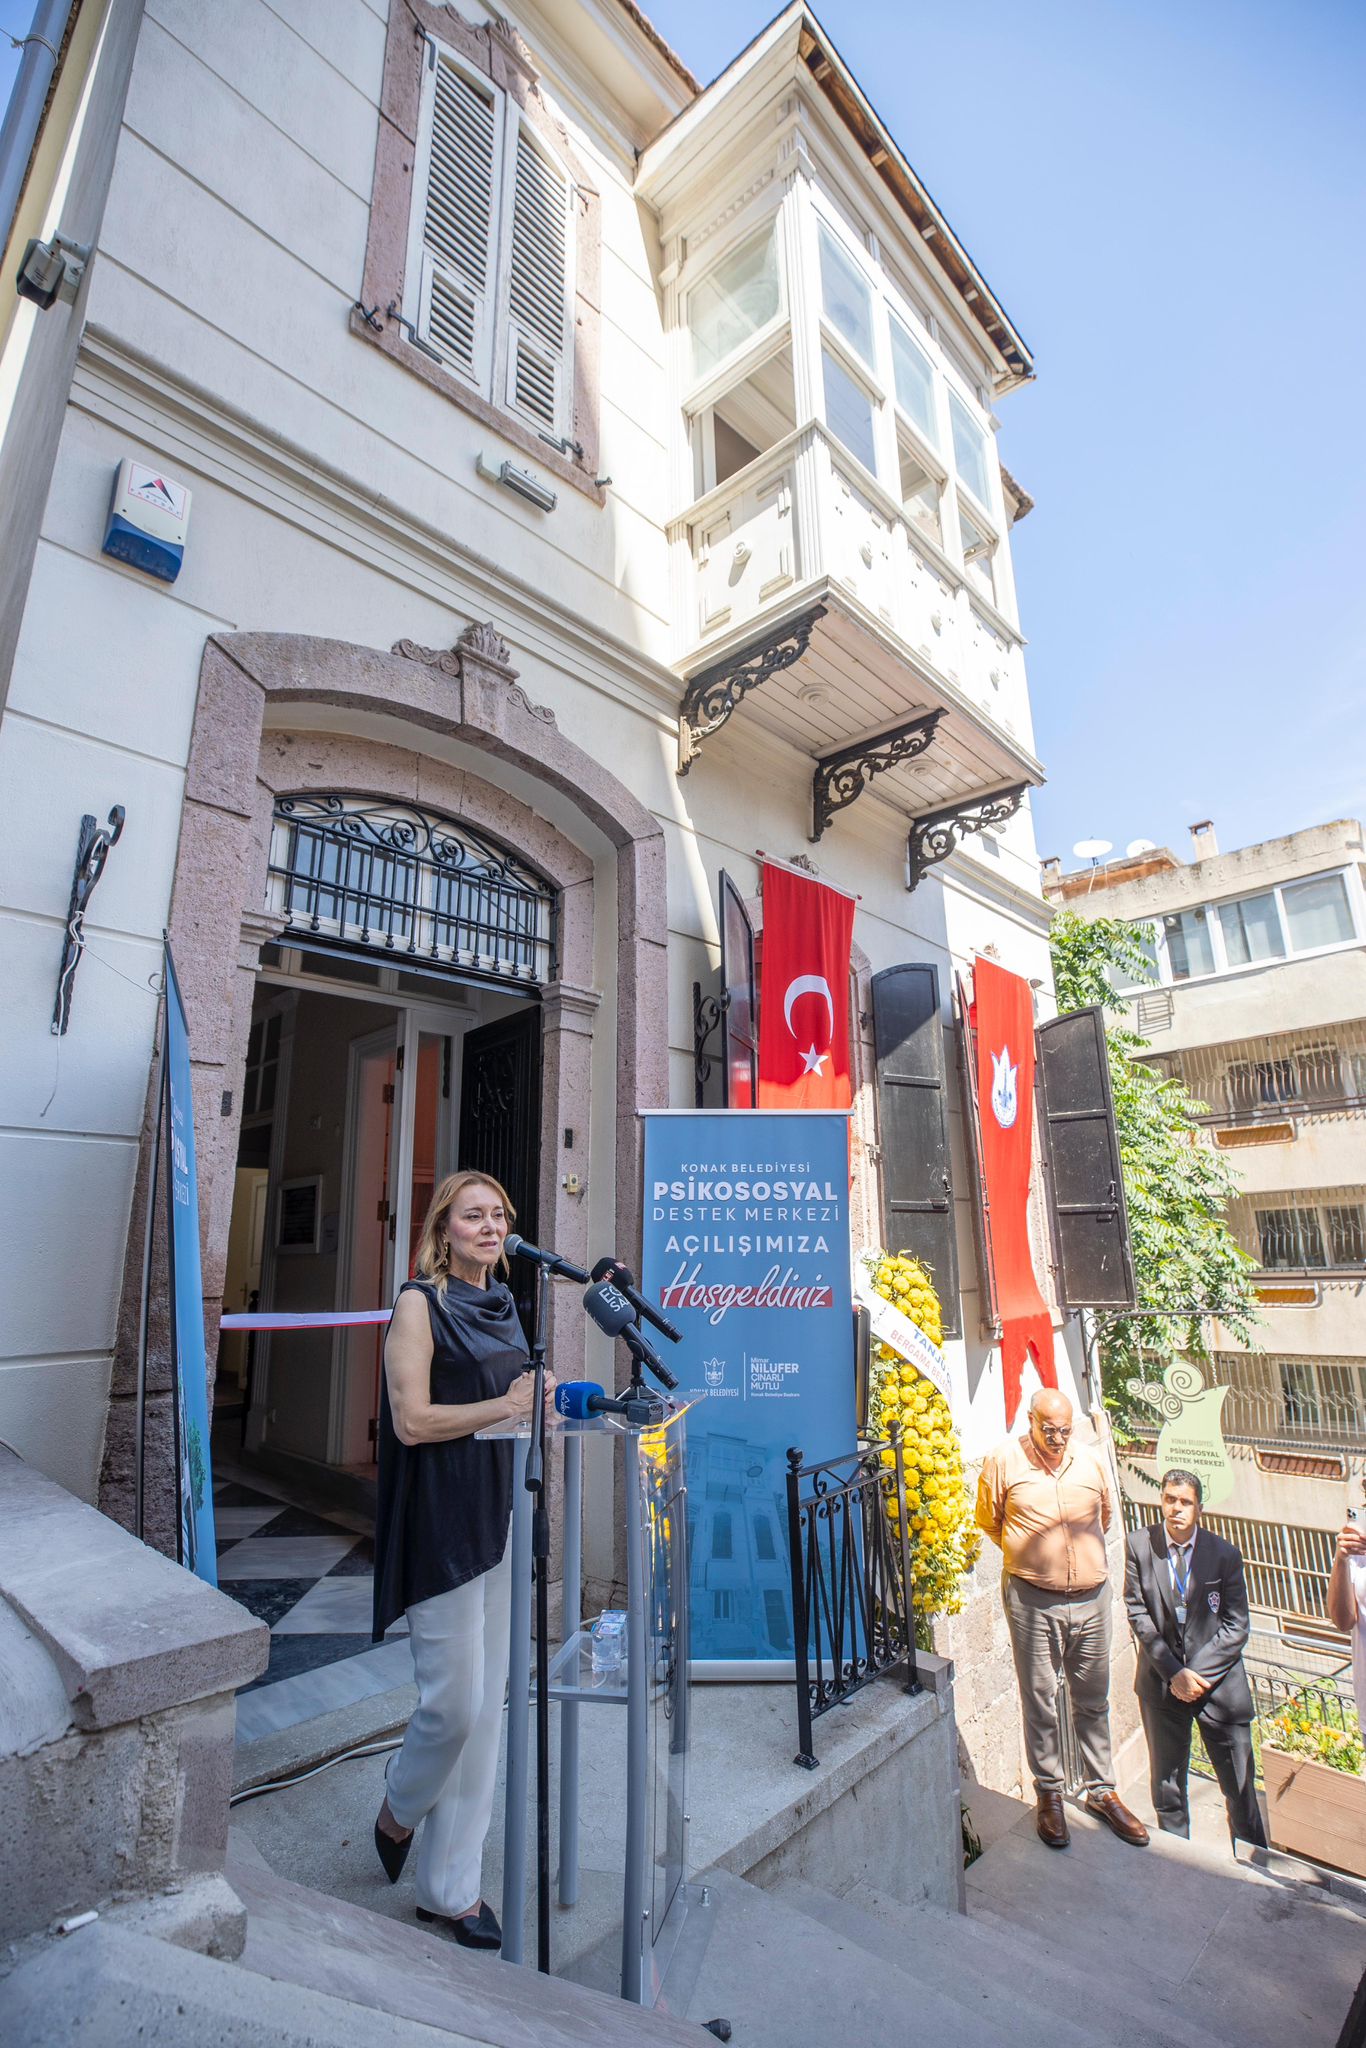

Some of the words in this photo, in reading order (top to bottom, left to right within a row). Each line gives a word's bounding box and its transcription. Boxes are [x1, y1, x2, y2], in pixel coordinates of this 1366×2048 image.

[681, 1163, 727, 1173] KONAK
[731, 1161, 810, 1173] BELEDİYESİ
[653, 1175, 838, 1201] PSİKOSOSYAL
[653, 1207, 736, 1221] DESTEK
[745, 1204, 839, 1221] MERKEZİ
[664, 1235, 830, 1257] AÇILIŞIMIZA
[661, 1260, 831, 1326] Hoşgeldiniz
[890, 1329, 930, 1370] BERGAMA
[750, 1373, 785, 1382] ÇINARLI
[709, 1387, 739, 1397] BELEDİYESİ
[750, 1382, 780, 1391] MUTLU
[1169, 1446, 1220, 1458] PSİKOSOSYAL
[1165, 1455, 1192, 1464] DESTEK
[1193, 1458, 1225, 1467] MERKEZİ
